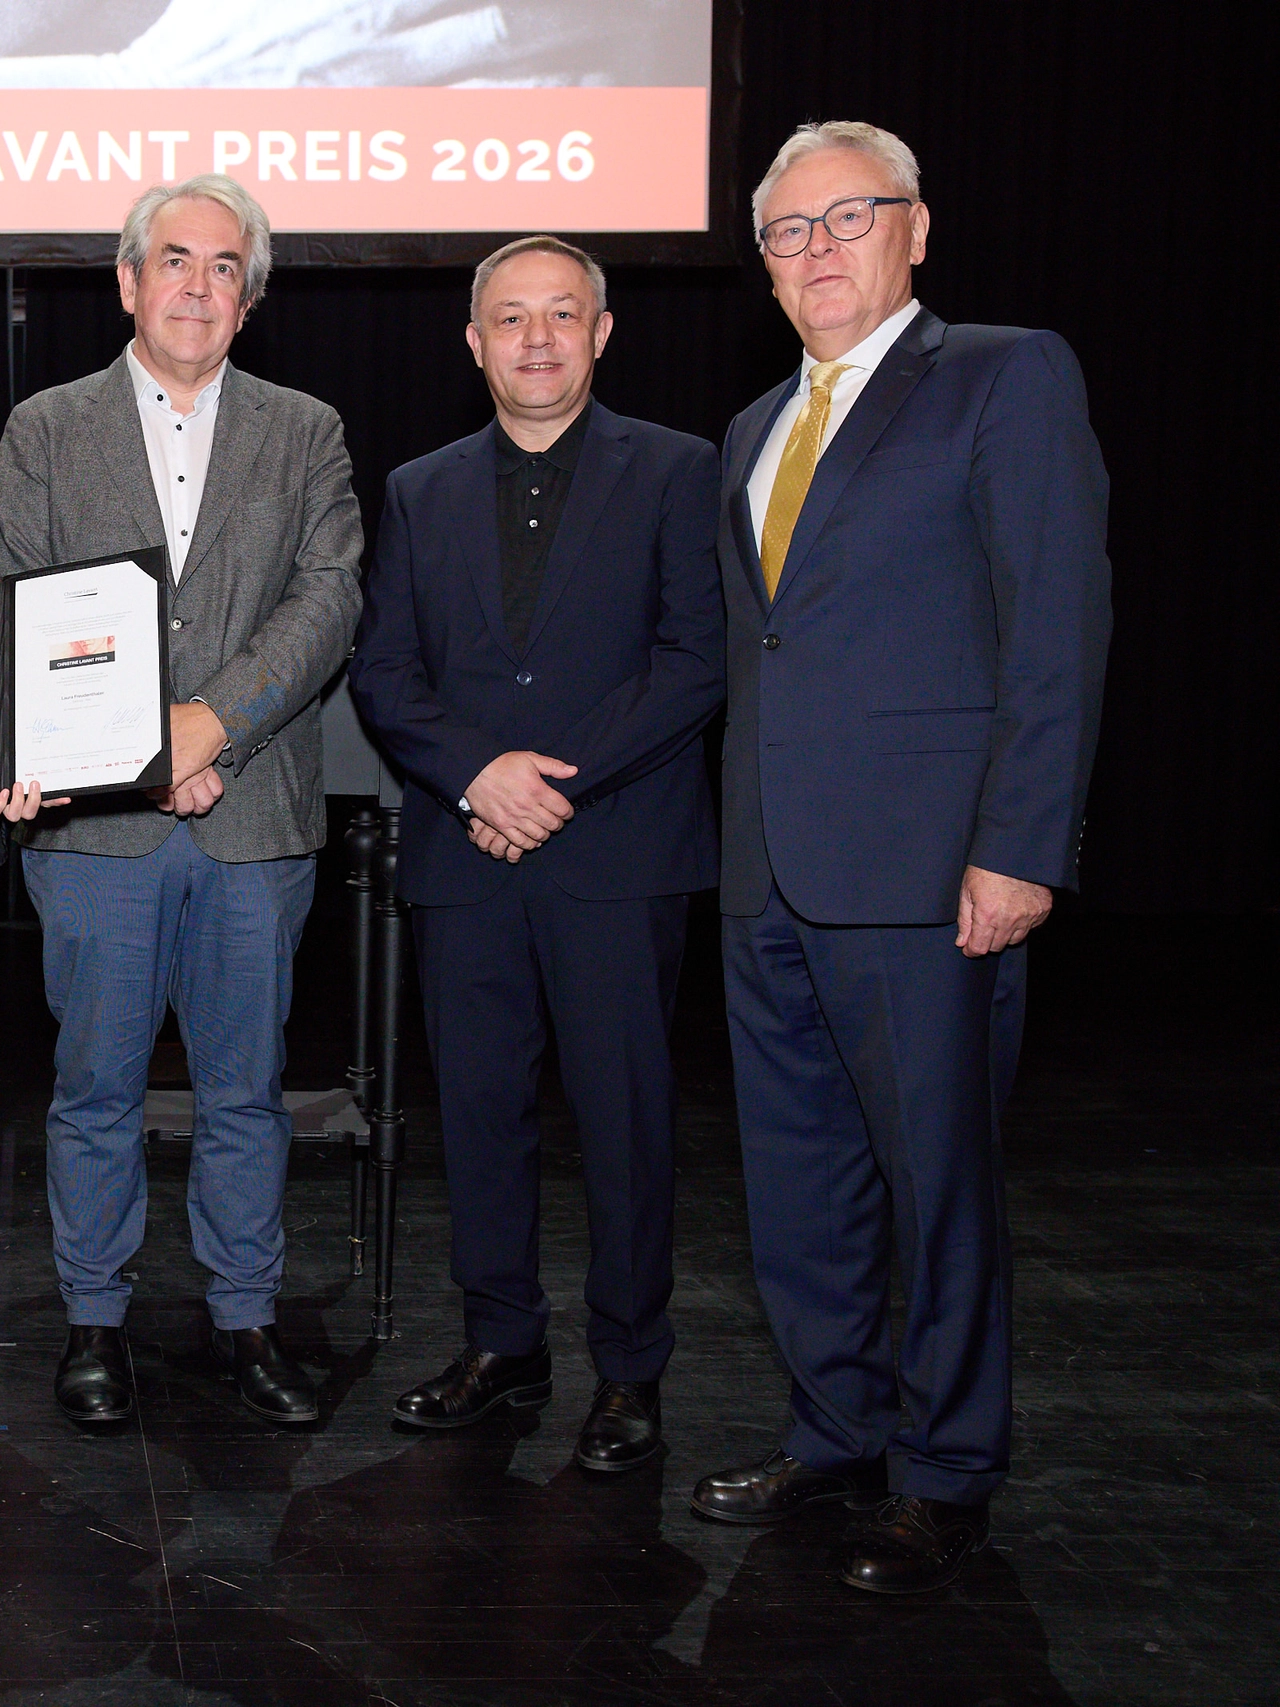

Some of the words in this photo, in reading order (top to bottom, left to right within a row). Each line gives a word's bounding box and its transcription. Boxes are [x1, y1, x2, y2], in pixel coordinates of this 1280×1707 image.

[213, 130, 408, 182] PREIS
[431, 130, 595, 182] 2026
[56, 659, 79, 668] CHRISTINE
[79, 657, 95, 665] LAVANT
